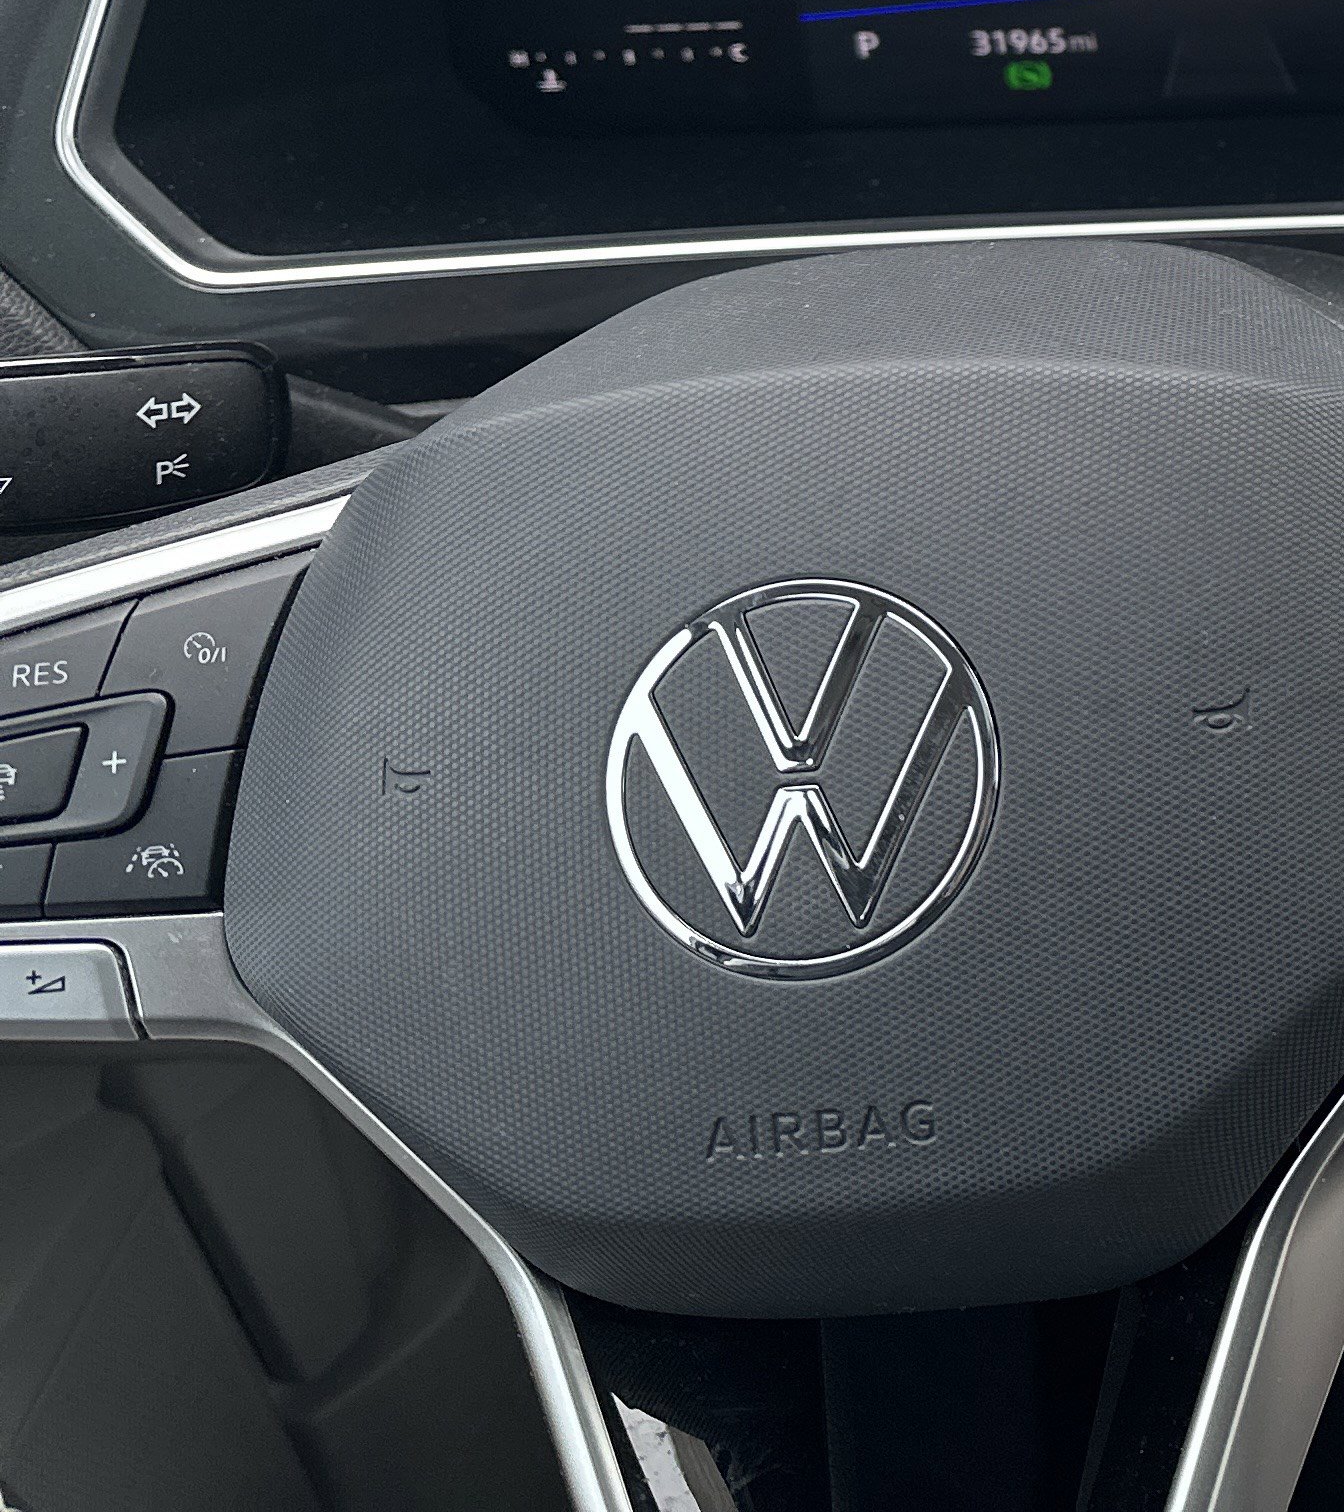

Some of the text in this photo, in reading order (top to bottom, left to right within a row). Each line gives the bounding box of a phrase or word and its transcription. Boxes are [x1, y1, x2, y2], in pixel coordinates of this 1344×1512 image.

[854, 30, 881, 59] P
[12, 660, 69, 688] RES
[705, 1099, 940, 1163] AIRBAG
